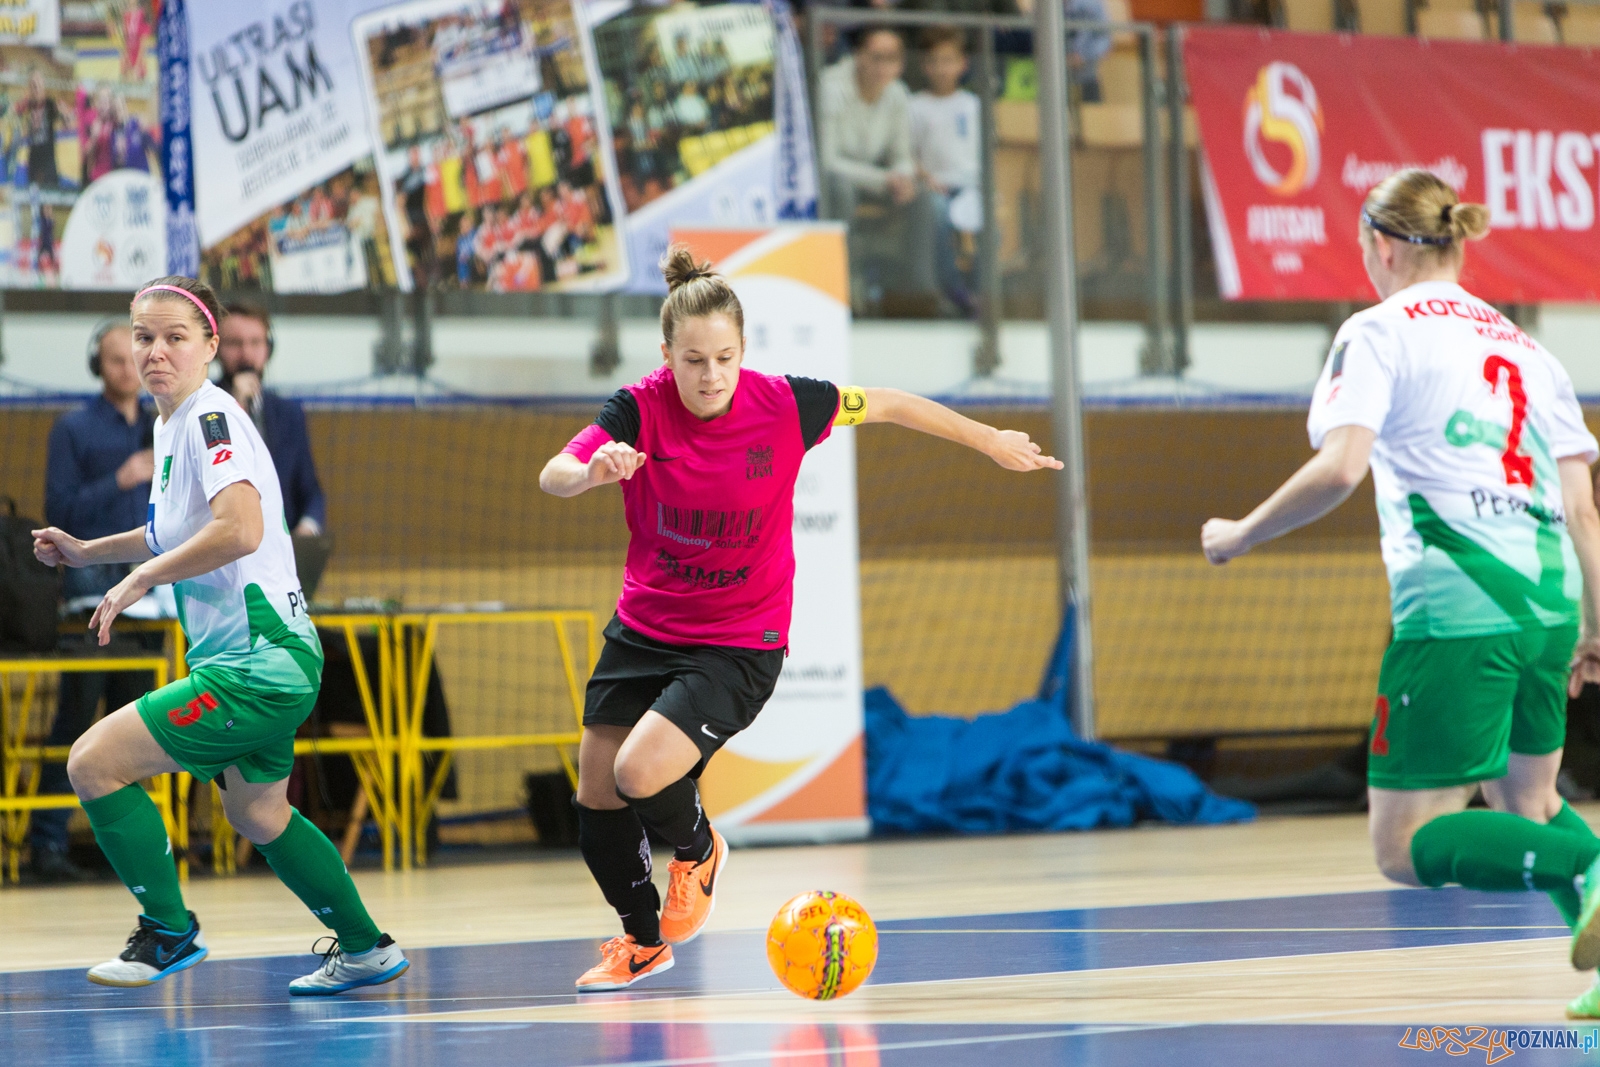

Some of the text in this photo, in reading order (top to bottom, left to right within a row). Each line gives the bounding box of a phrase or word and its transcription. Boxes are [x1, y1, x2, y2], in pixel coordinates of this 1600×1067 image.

[196, 0, 313, 84] ULTRASI
[211, 40, 334, 142] UAM
[1482, 128, 1600, 231] EKS
[842, 392, 867, 414] C
[1483, 354, 1535, 488] 2
[662, 527, 713, 549] inventory
[167, 690, 219, 727] 5
[1370, 694, 1390, 757] 2
[799, 905, 861, 921] SELECT
